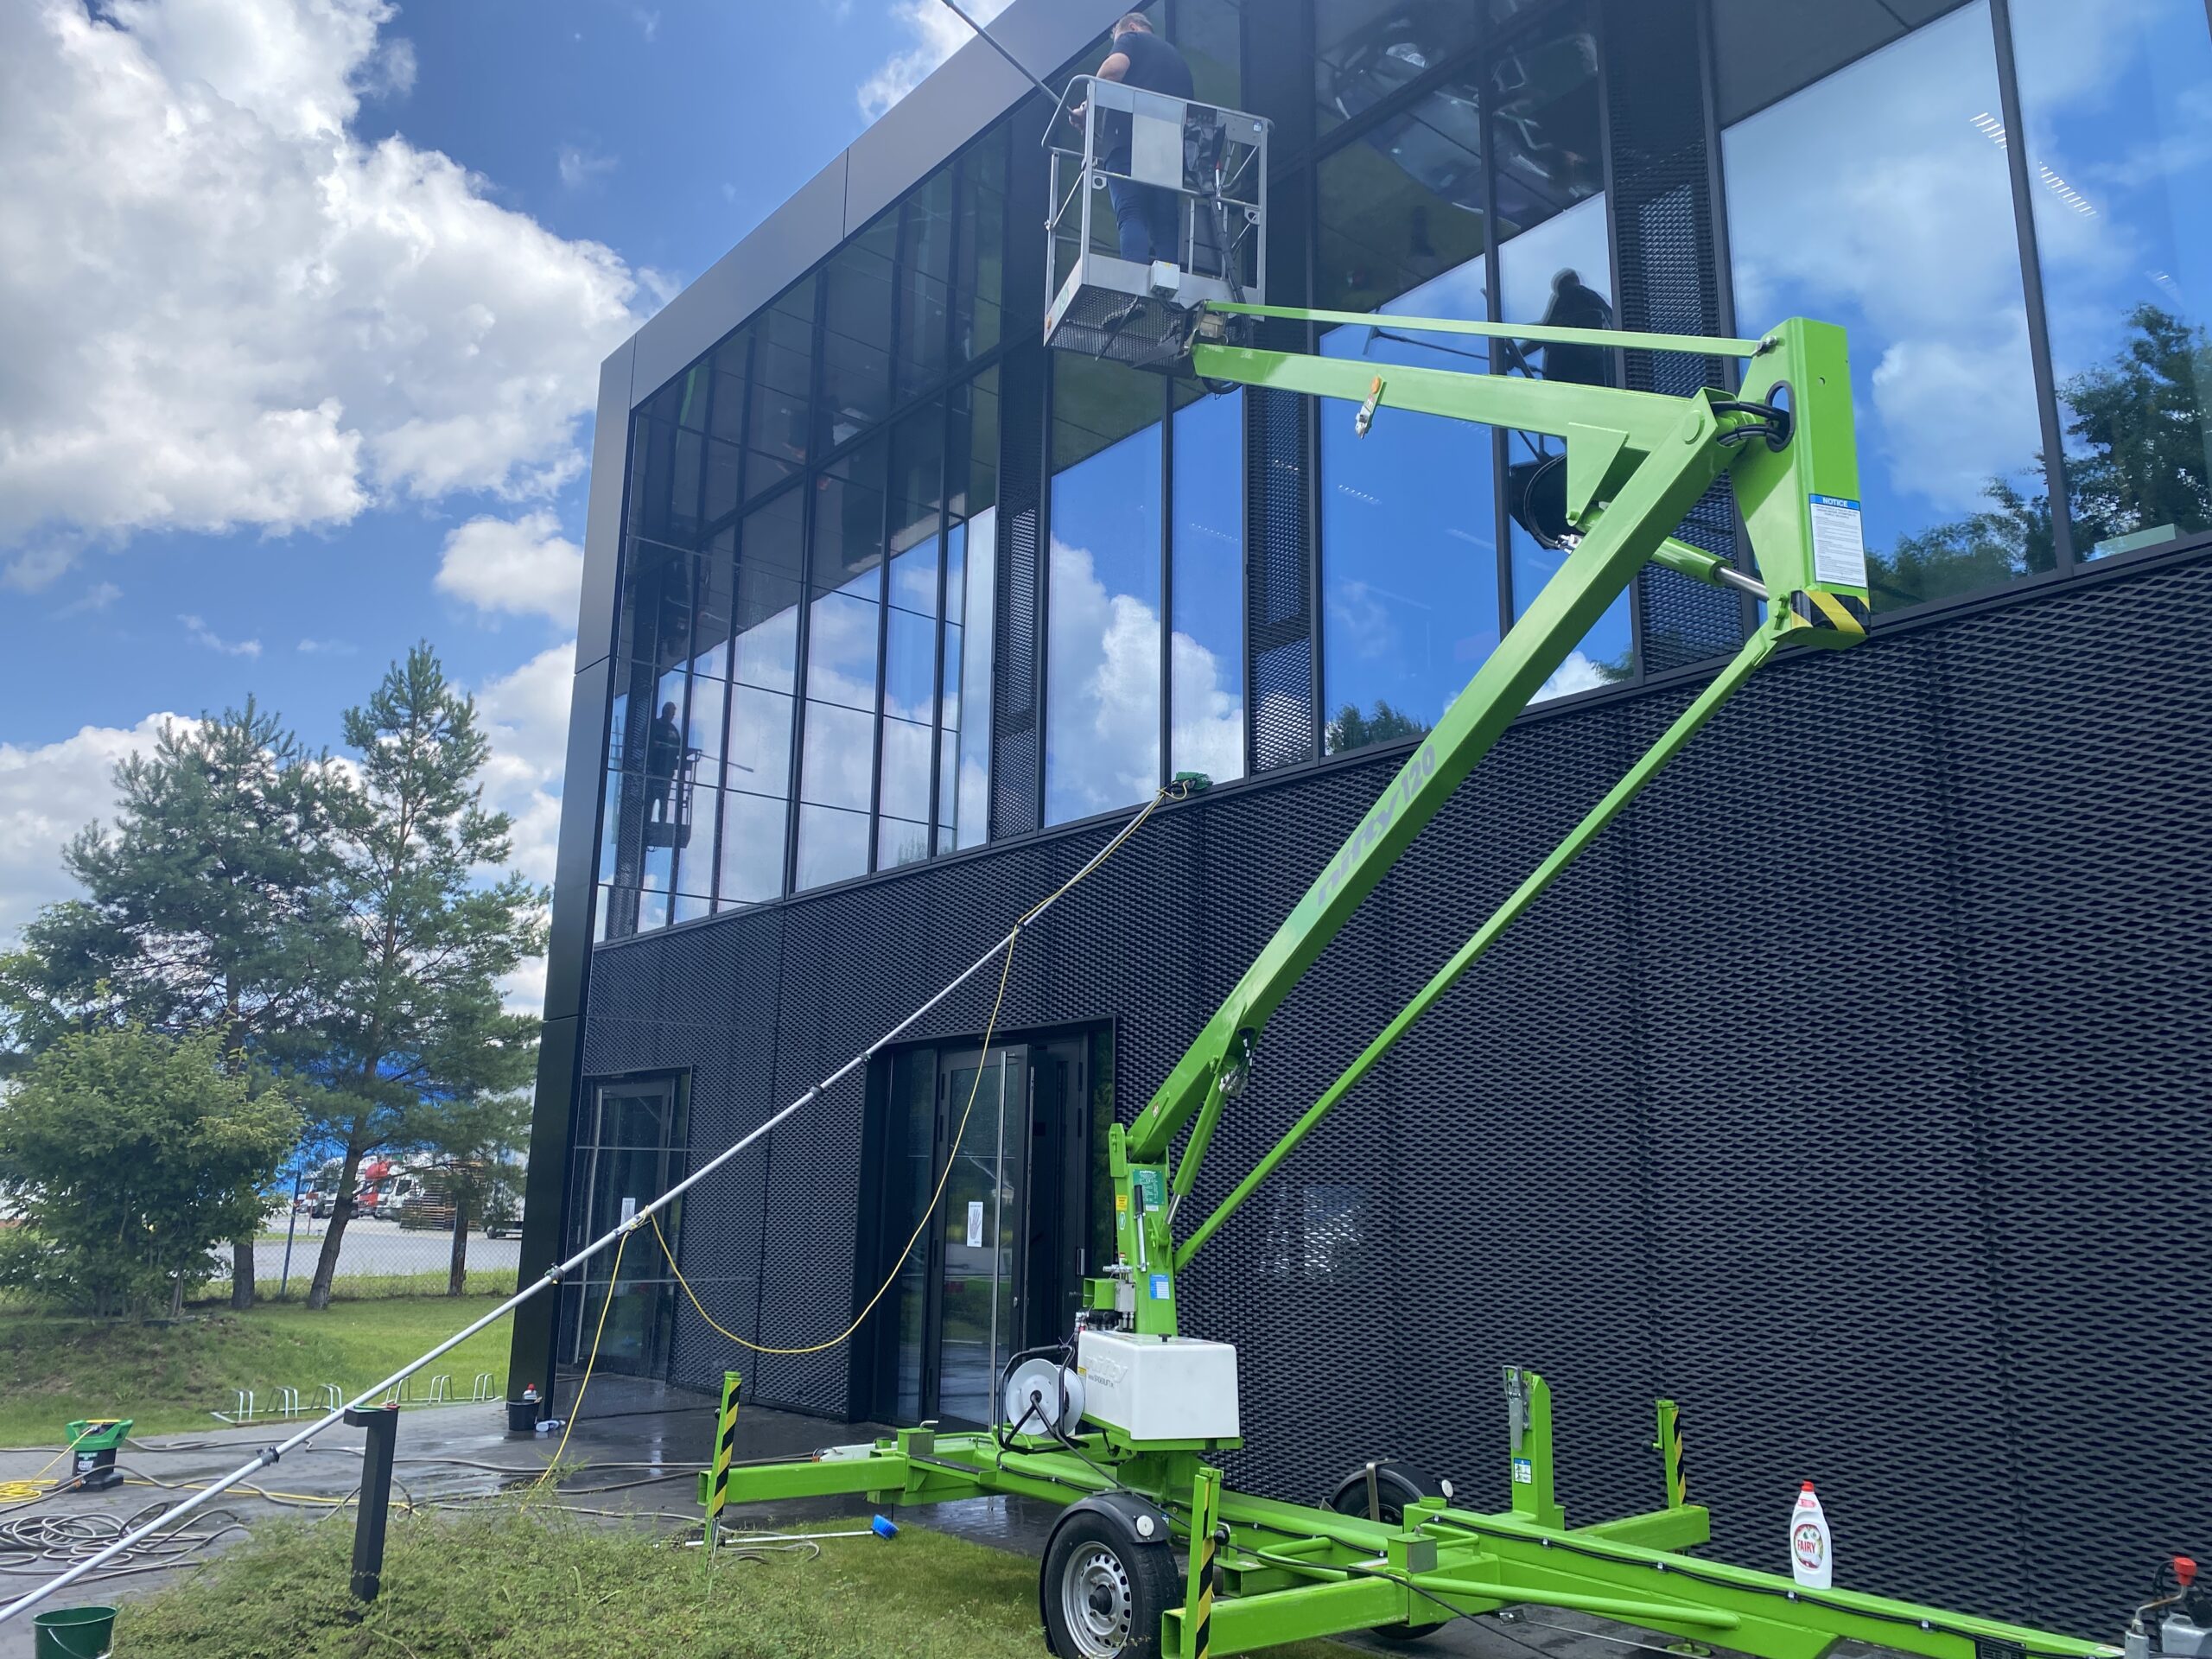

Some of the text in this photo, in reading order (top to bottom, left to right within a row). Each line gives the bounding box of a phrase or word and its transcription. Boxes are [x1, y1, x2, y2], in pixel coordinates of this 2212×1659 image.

[1822, 497, 1848, 507] NOTICE
[1400, 744, 1435, 804] 120
[1797, 1539, 1815, 1554] FAIRY
